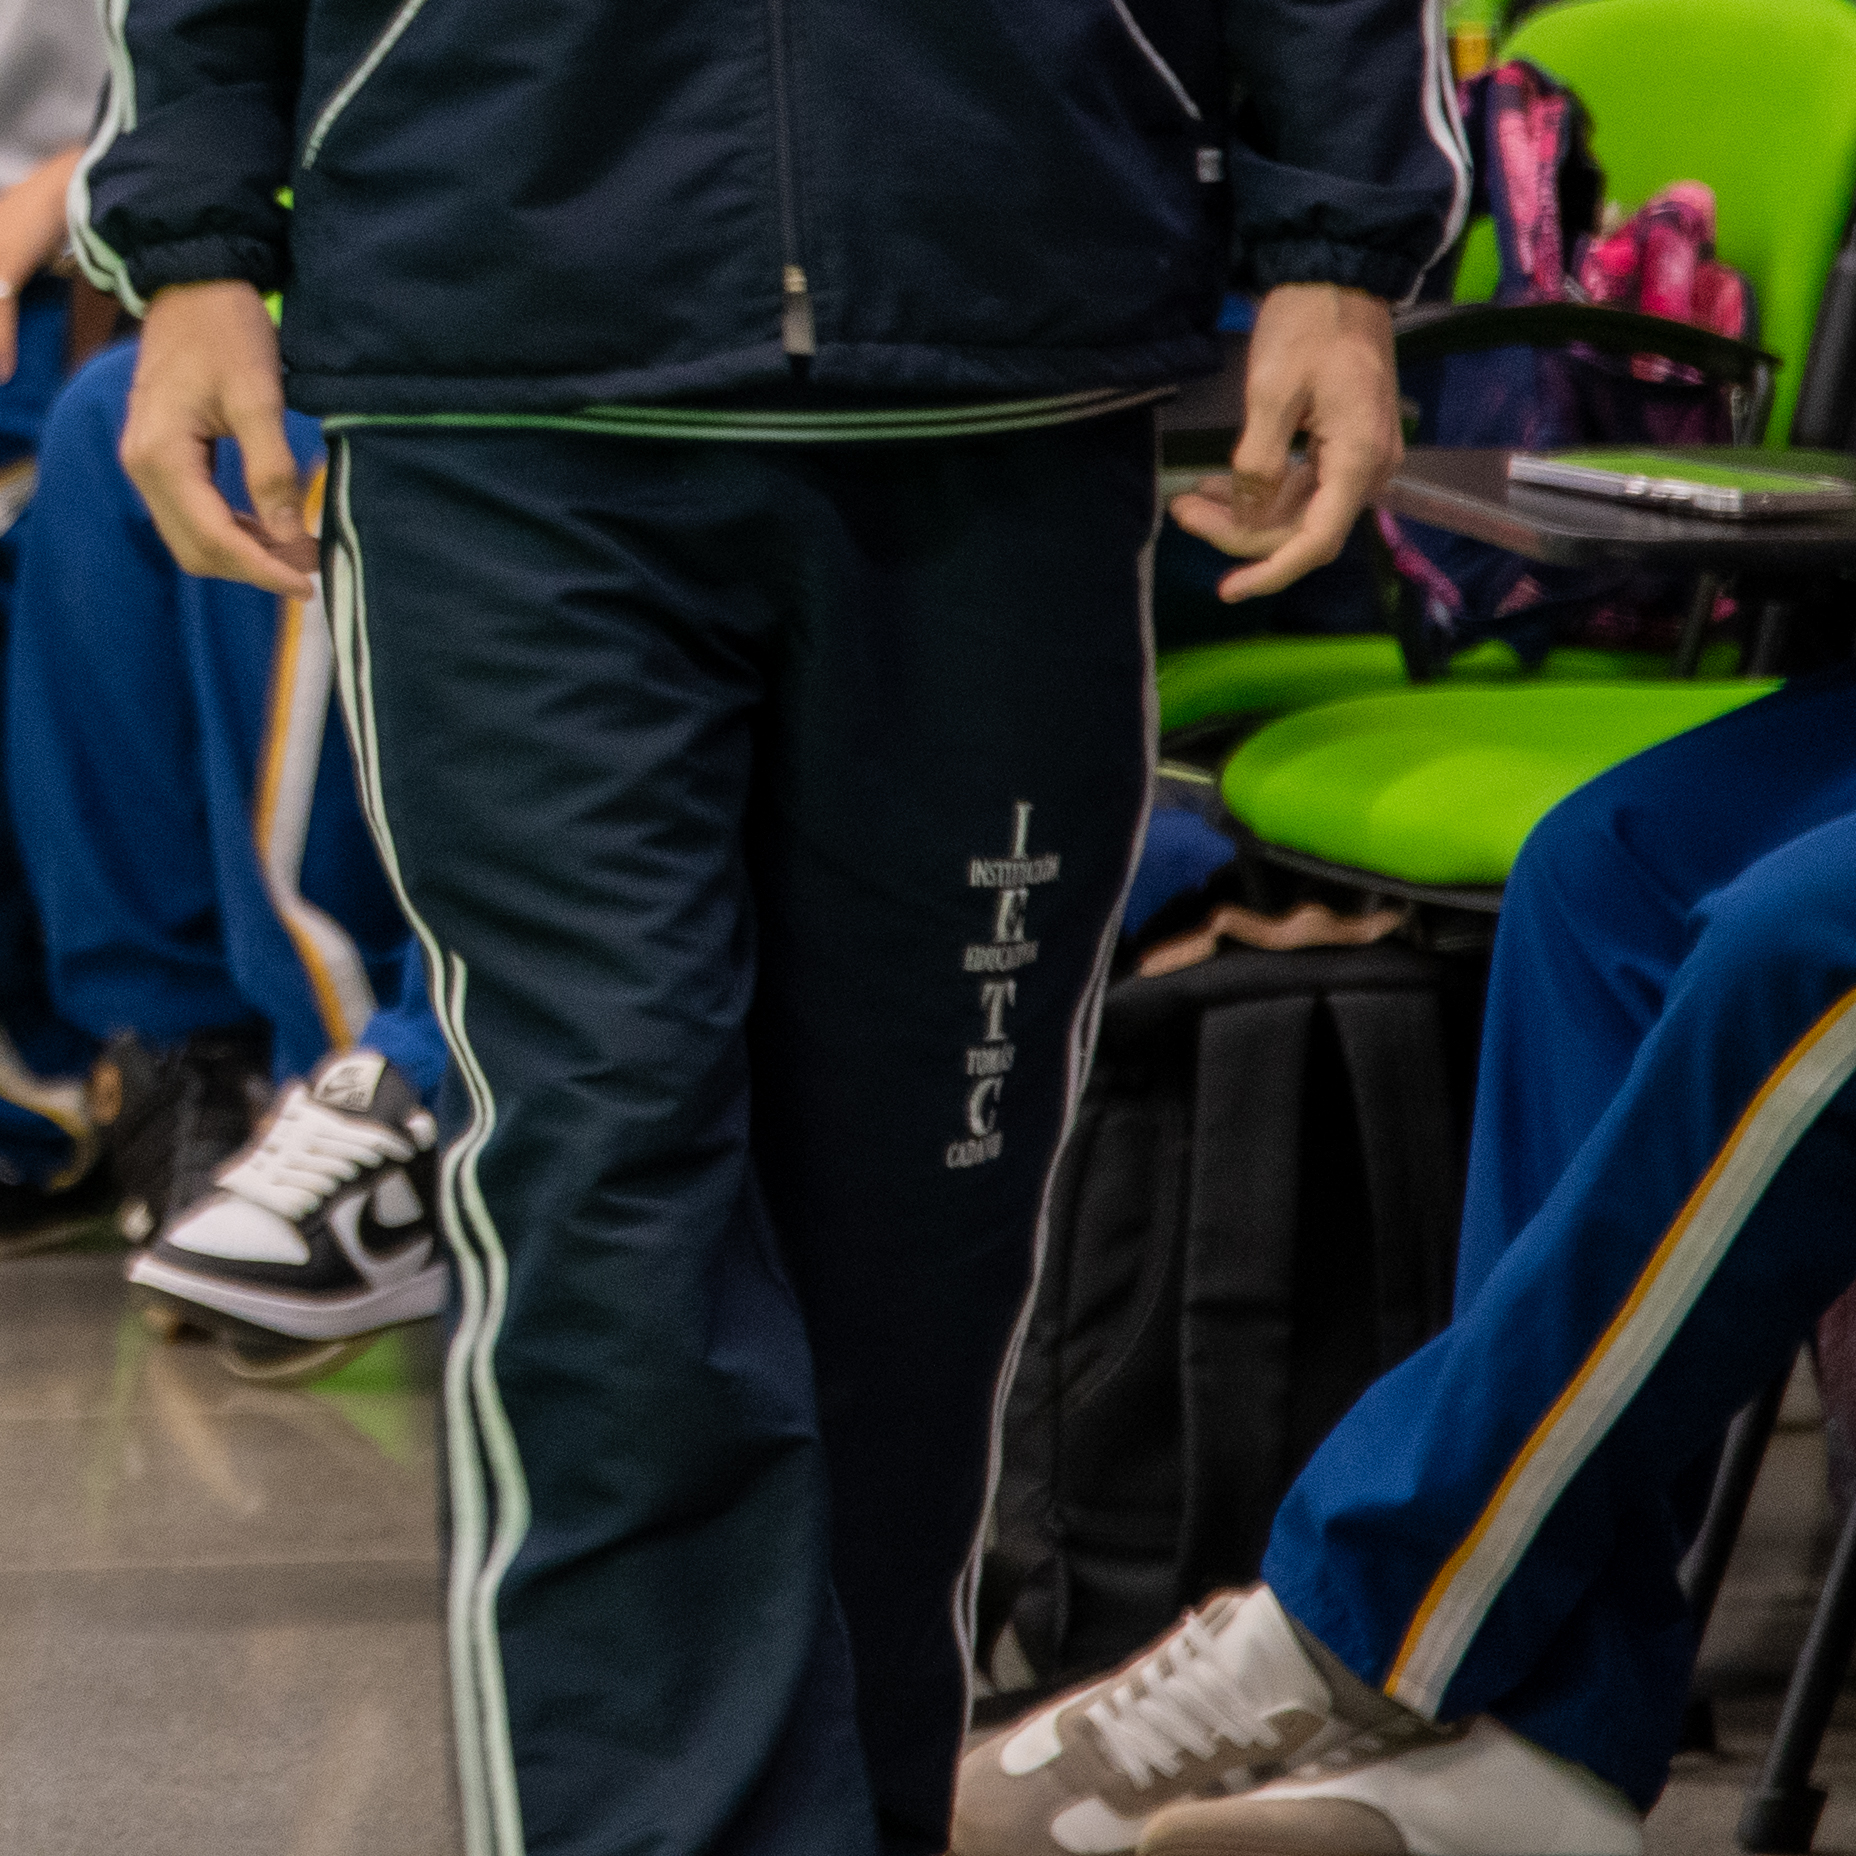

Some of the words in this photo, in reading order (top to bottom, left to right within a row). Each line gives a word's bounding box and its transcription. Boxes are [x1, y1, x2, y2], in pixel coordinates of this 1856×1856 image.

[1013, 800, 1034, 860] I
[980, 978, 1017, 1042] T
[969, 1075, 1005, 1138] C
